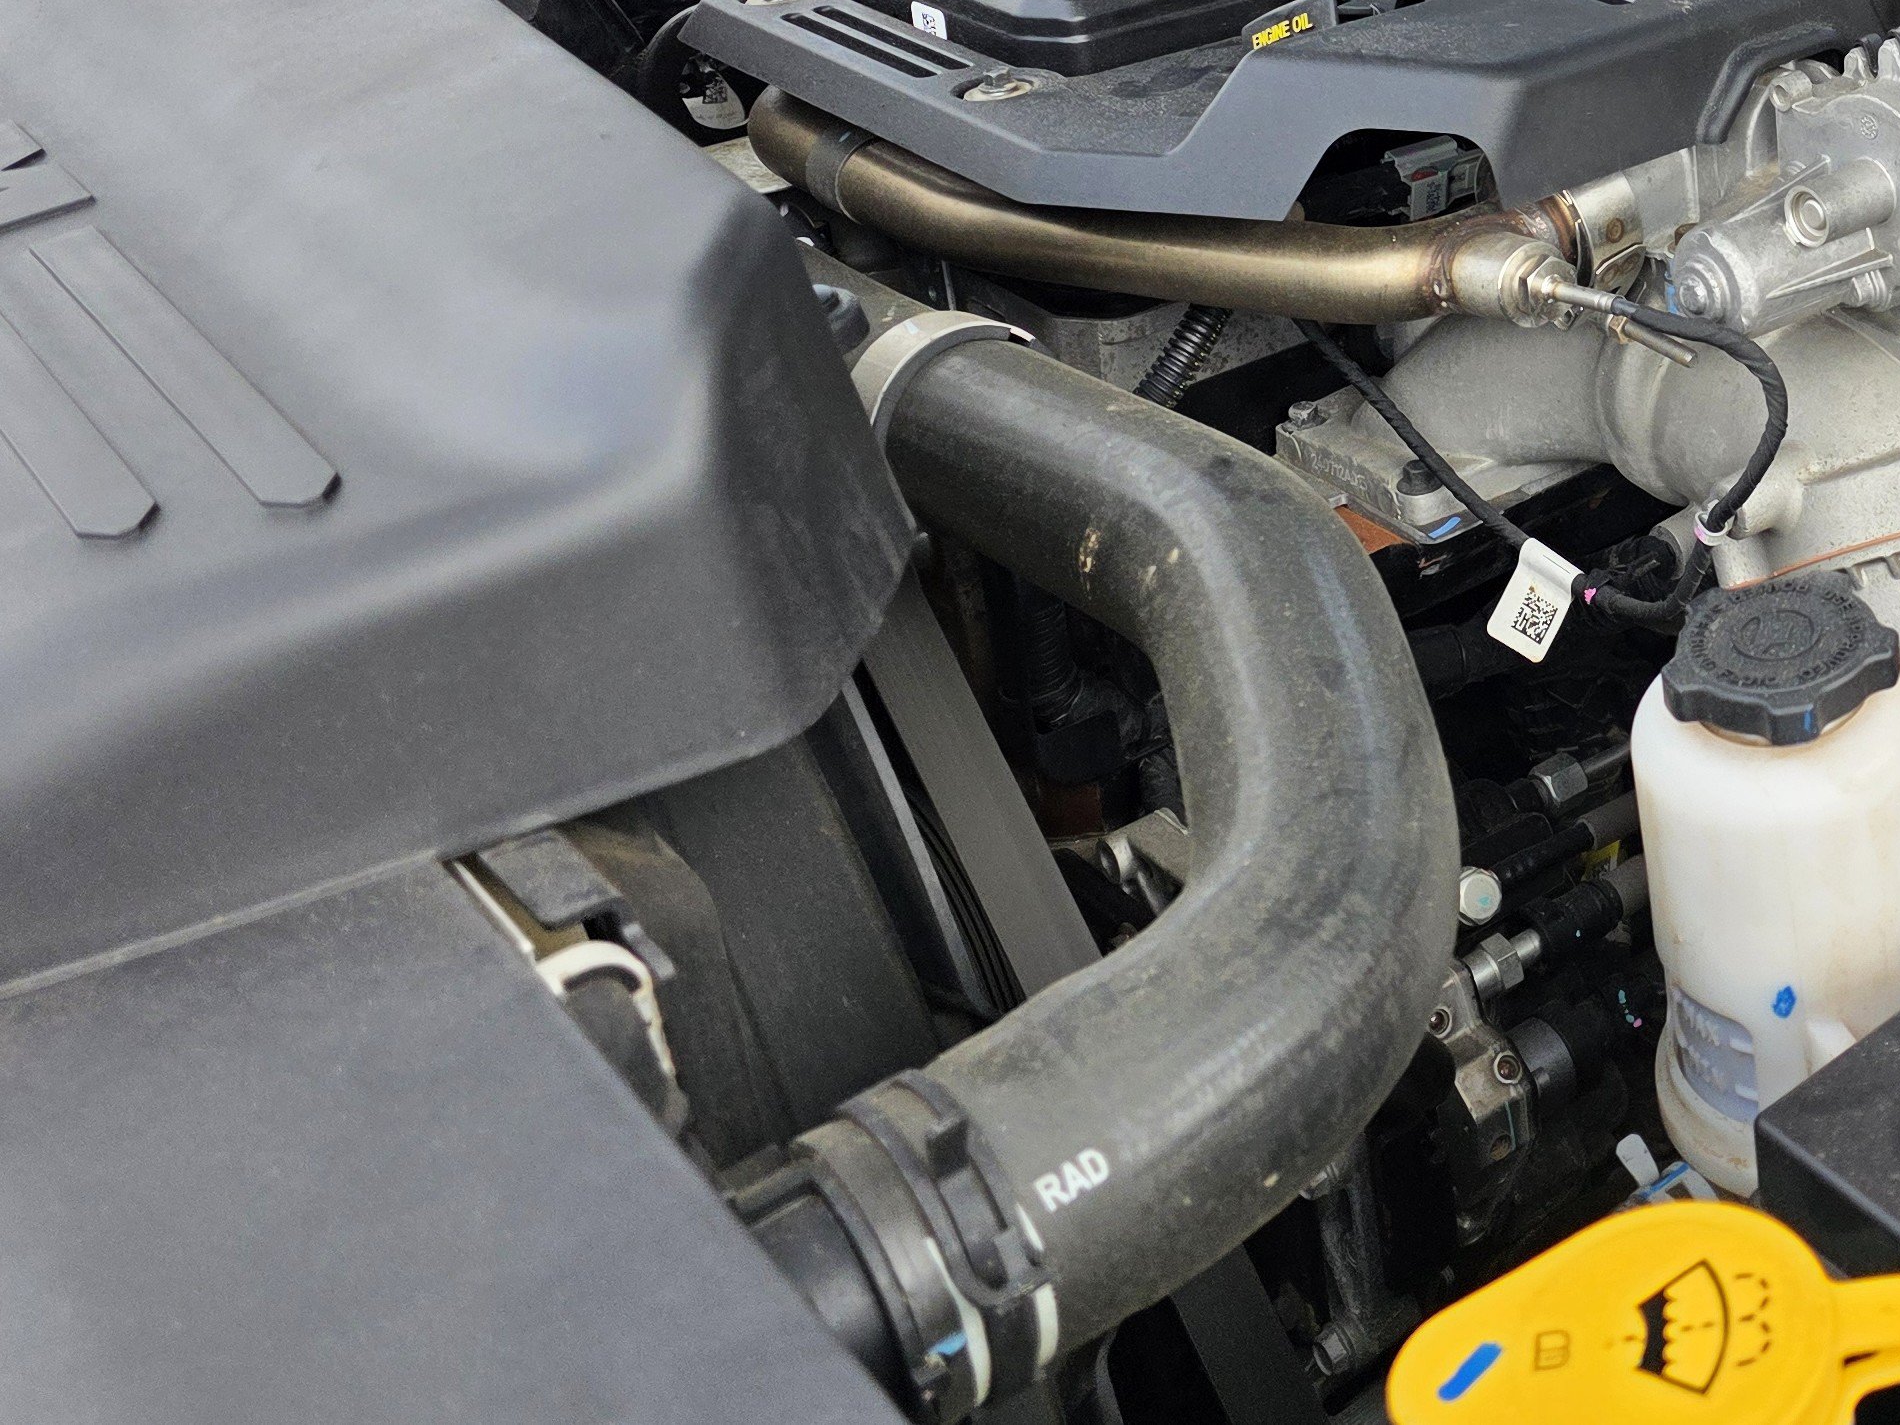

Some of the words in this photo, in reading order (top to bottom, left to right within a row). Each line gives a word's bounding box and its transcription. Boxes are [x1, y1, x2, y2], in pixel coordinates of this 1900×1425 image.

[1252, 20, 1291, 50] ENGINE
[1291, 12, 1314, 33] OIL
[1032, 1147, 1110, 1213] RAD
